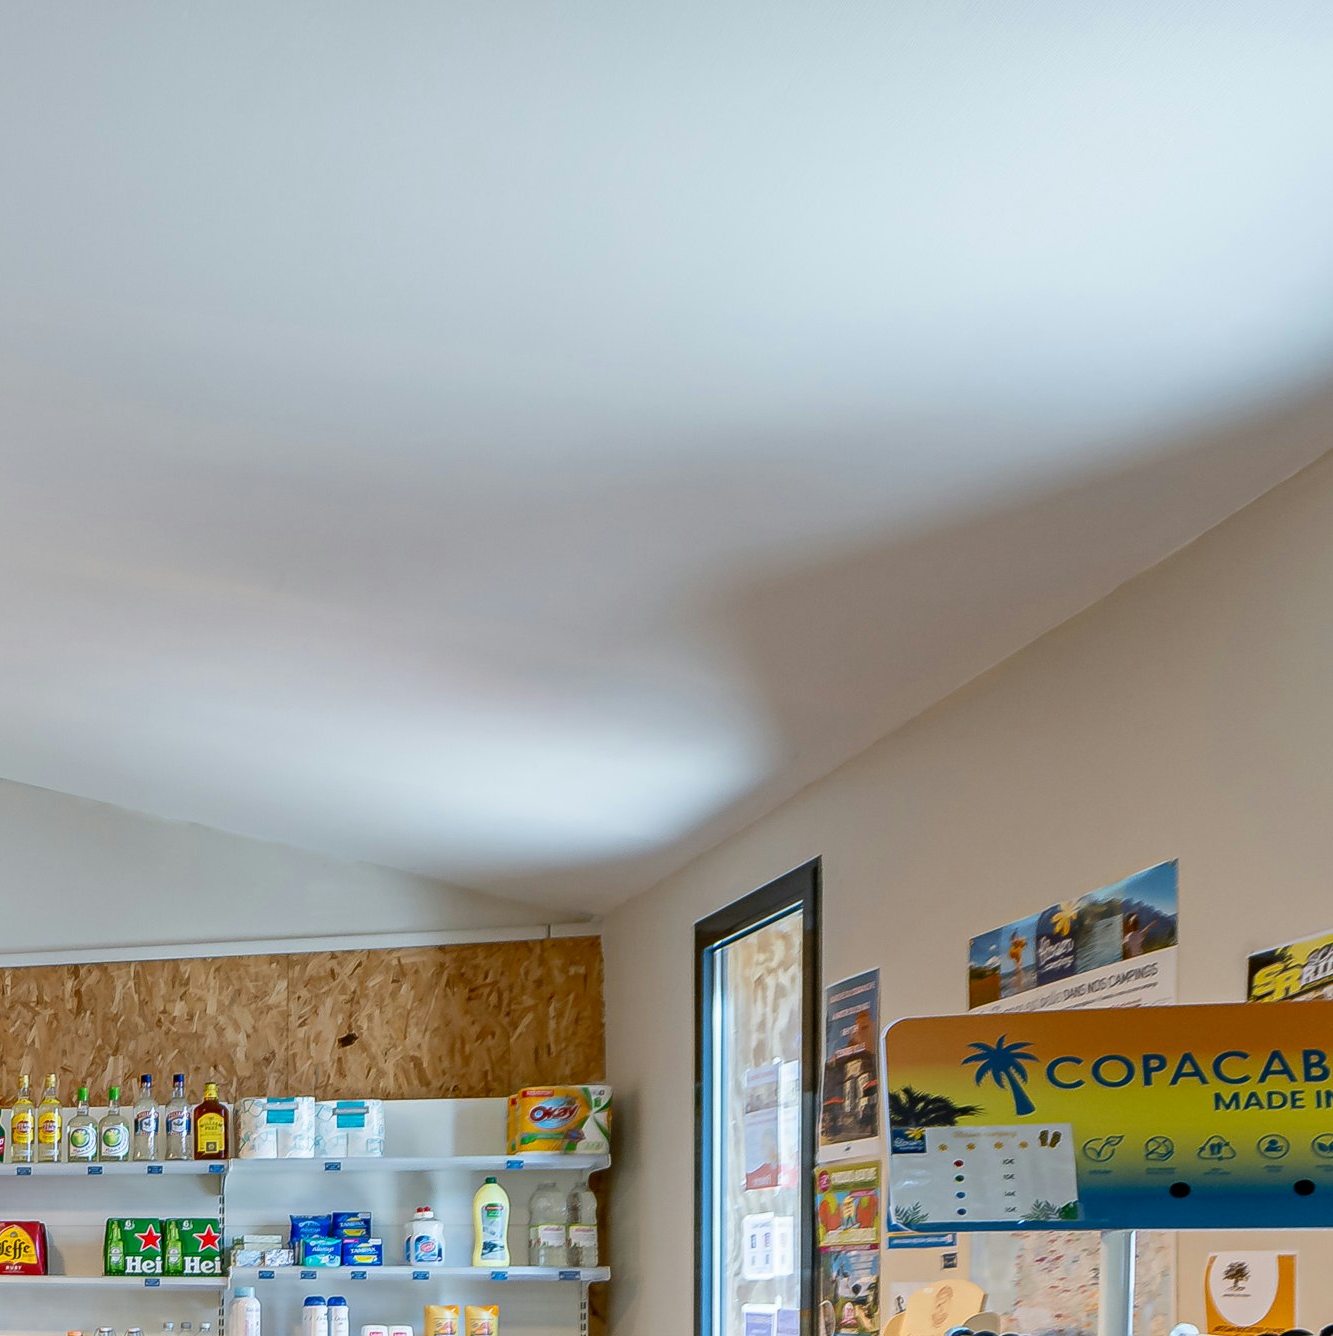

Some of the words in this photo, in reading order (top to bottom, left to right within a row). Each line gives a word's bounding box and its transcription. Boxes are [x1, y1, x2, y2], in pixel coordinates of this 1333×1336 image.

[1045, 1048, 1331, 1089] COPACAB
[1213, 1089, 1306, 1111] MADE
[528, 1103, 581, 1122] Okay
